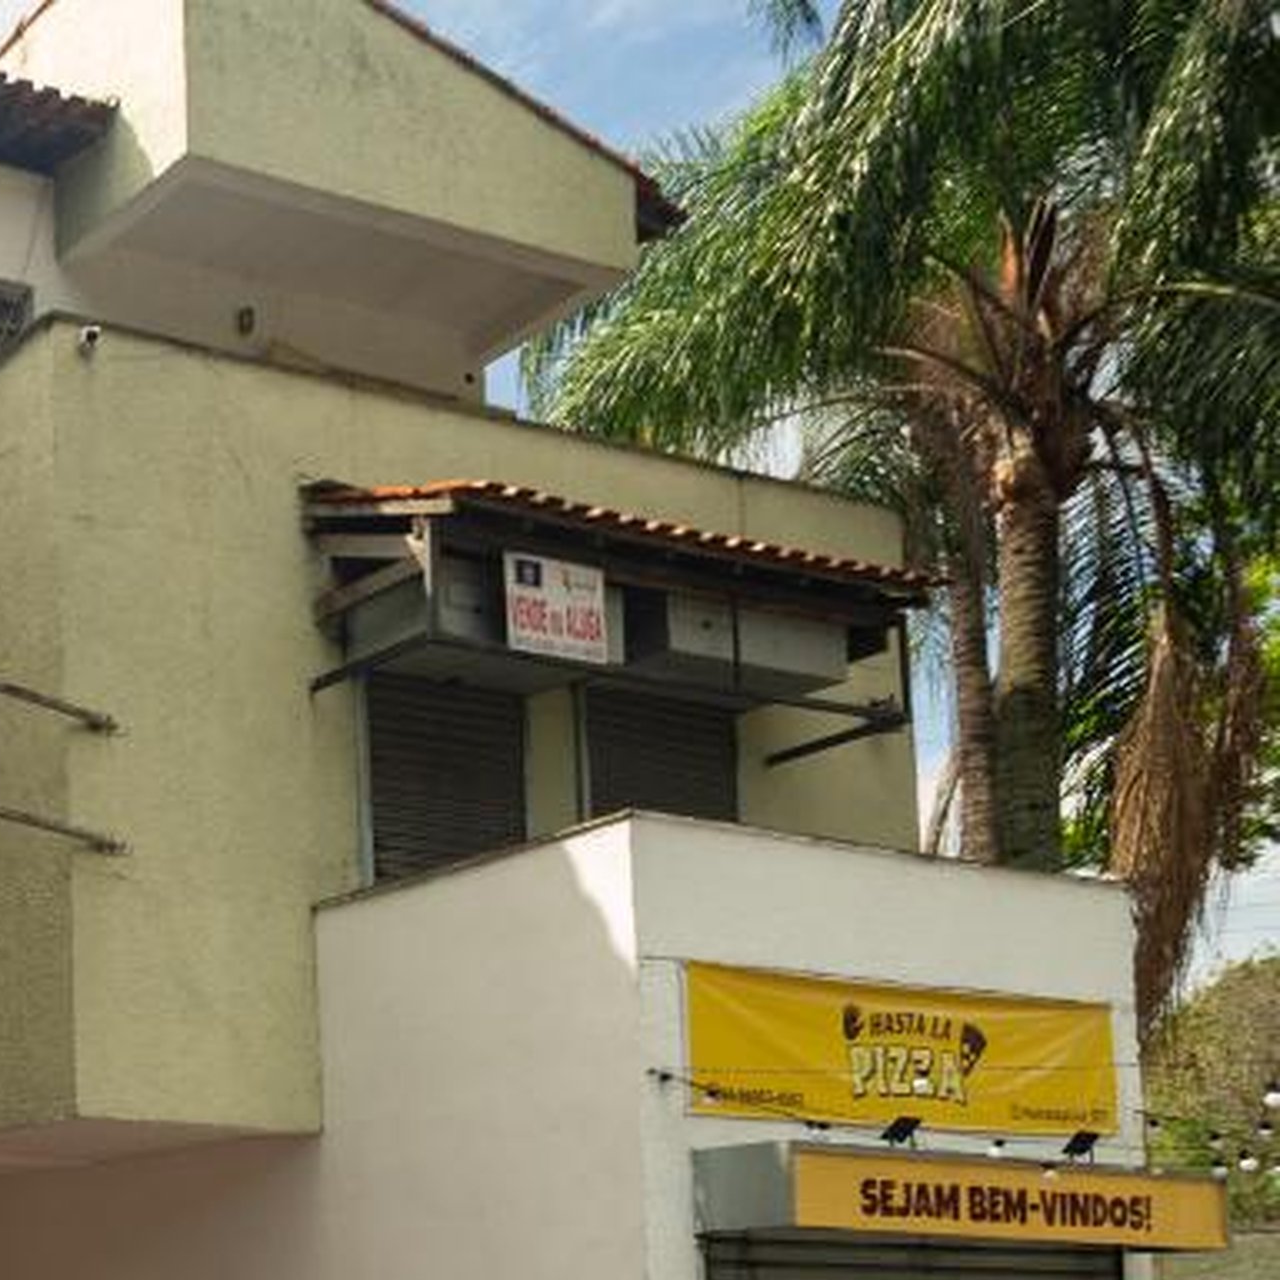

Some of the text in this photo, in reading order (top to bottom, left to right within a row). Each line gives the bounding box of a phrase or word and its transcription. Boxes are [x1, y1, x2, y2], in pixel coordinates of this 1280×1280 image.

[869, 1011, 952, 1041] HASTA LA
[850, 1042, 968, 1106] PIZZA
[859, 1178, 1152, 1234] SEJAM BEM-VINDOS!
